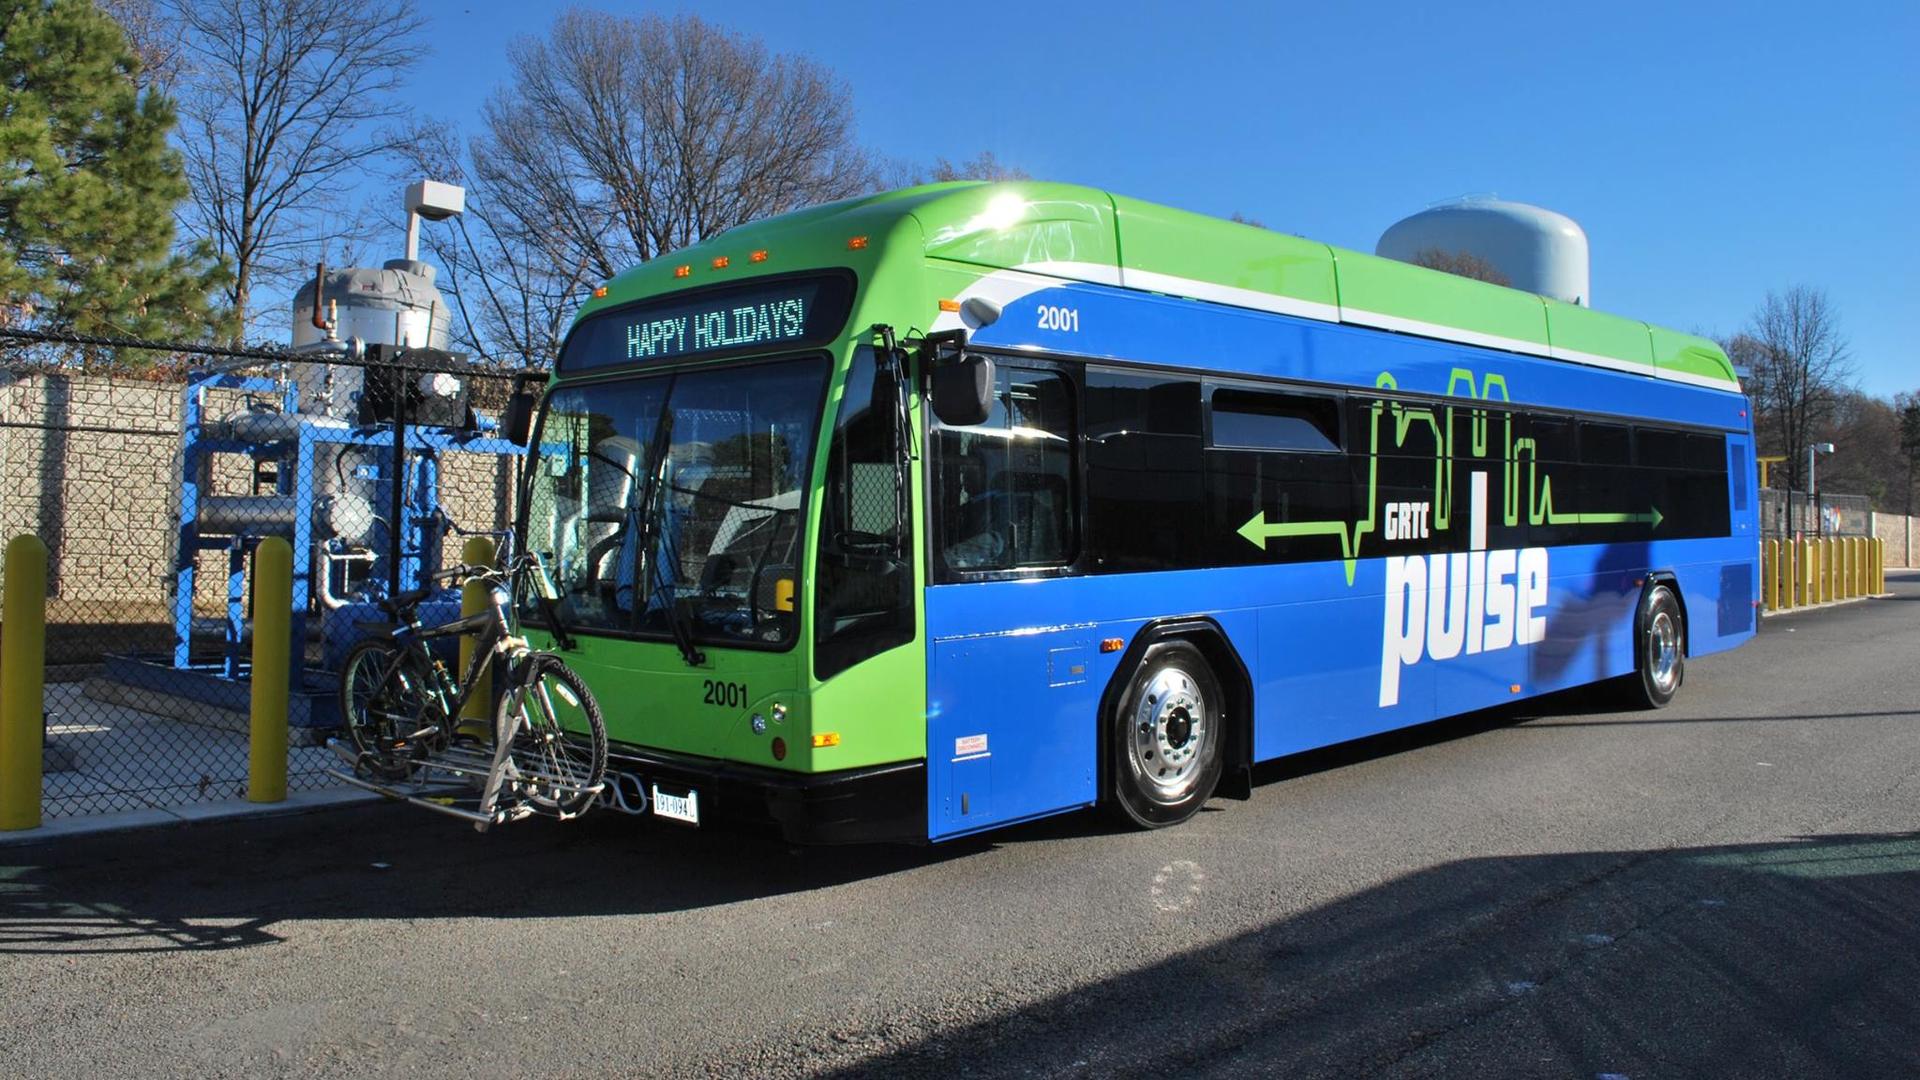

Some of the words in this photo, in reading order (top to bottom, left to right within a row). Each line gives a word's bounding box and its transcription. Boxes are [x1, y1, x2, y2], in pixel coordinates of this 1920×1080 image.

[627, 317, 687, 358] HAPPY
[694, 298, 804, 348] HOLIDAYS!
[1037, 304, 1079, 332] 2001
[1384, 502, 1430, 540] GRTC
[1379, 471, 1549, 708] pulse
[703, 679, 747, 709] 2001
